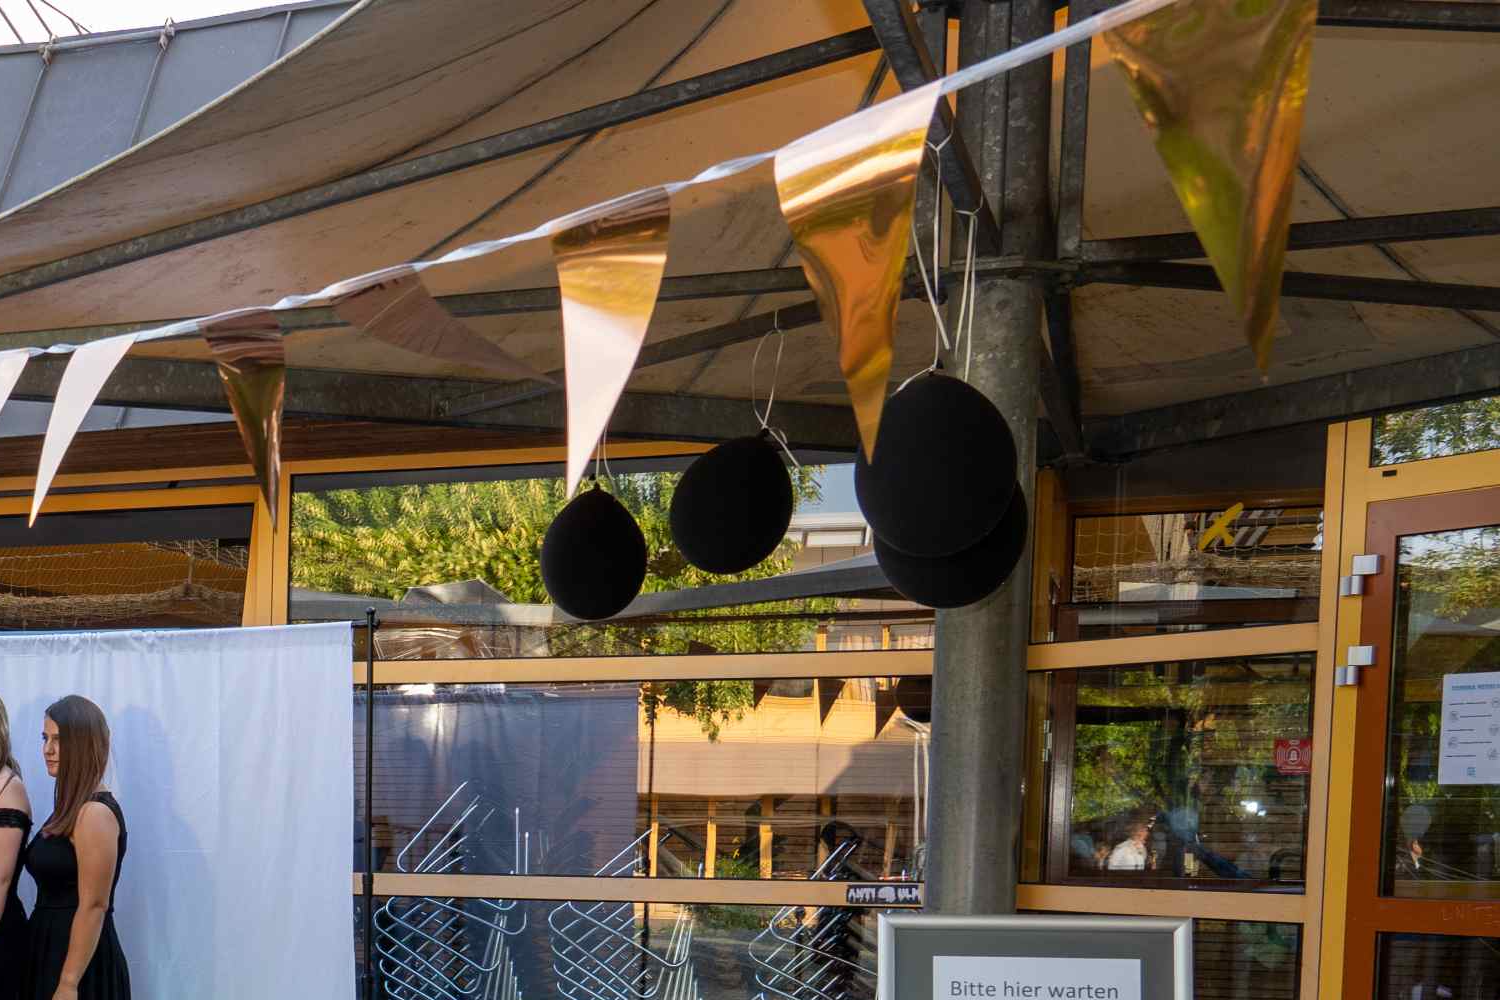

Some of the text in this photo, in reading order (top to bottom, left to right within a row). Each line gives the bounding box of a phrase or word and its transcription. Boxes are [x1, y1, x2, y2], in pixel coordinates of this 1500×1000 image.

[950, 980, 1119, 999] Bitte hier warten
